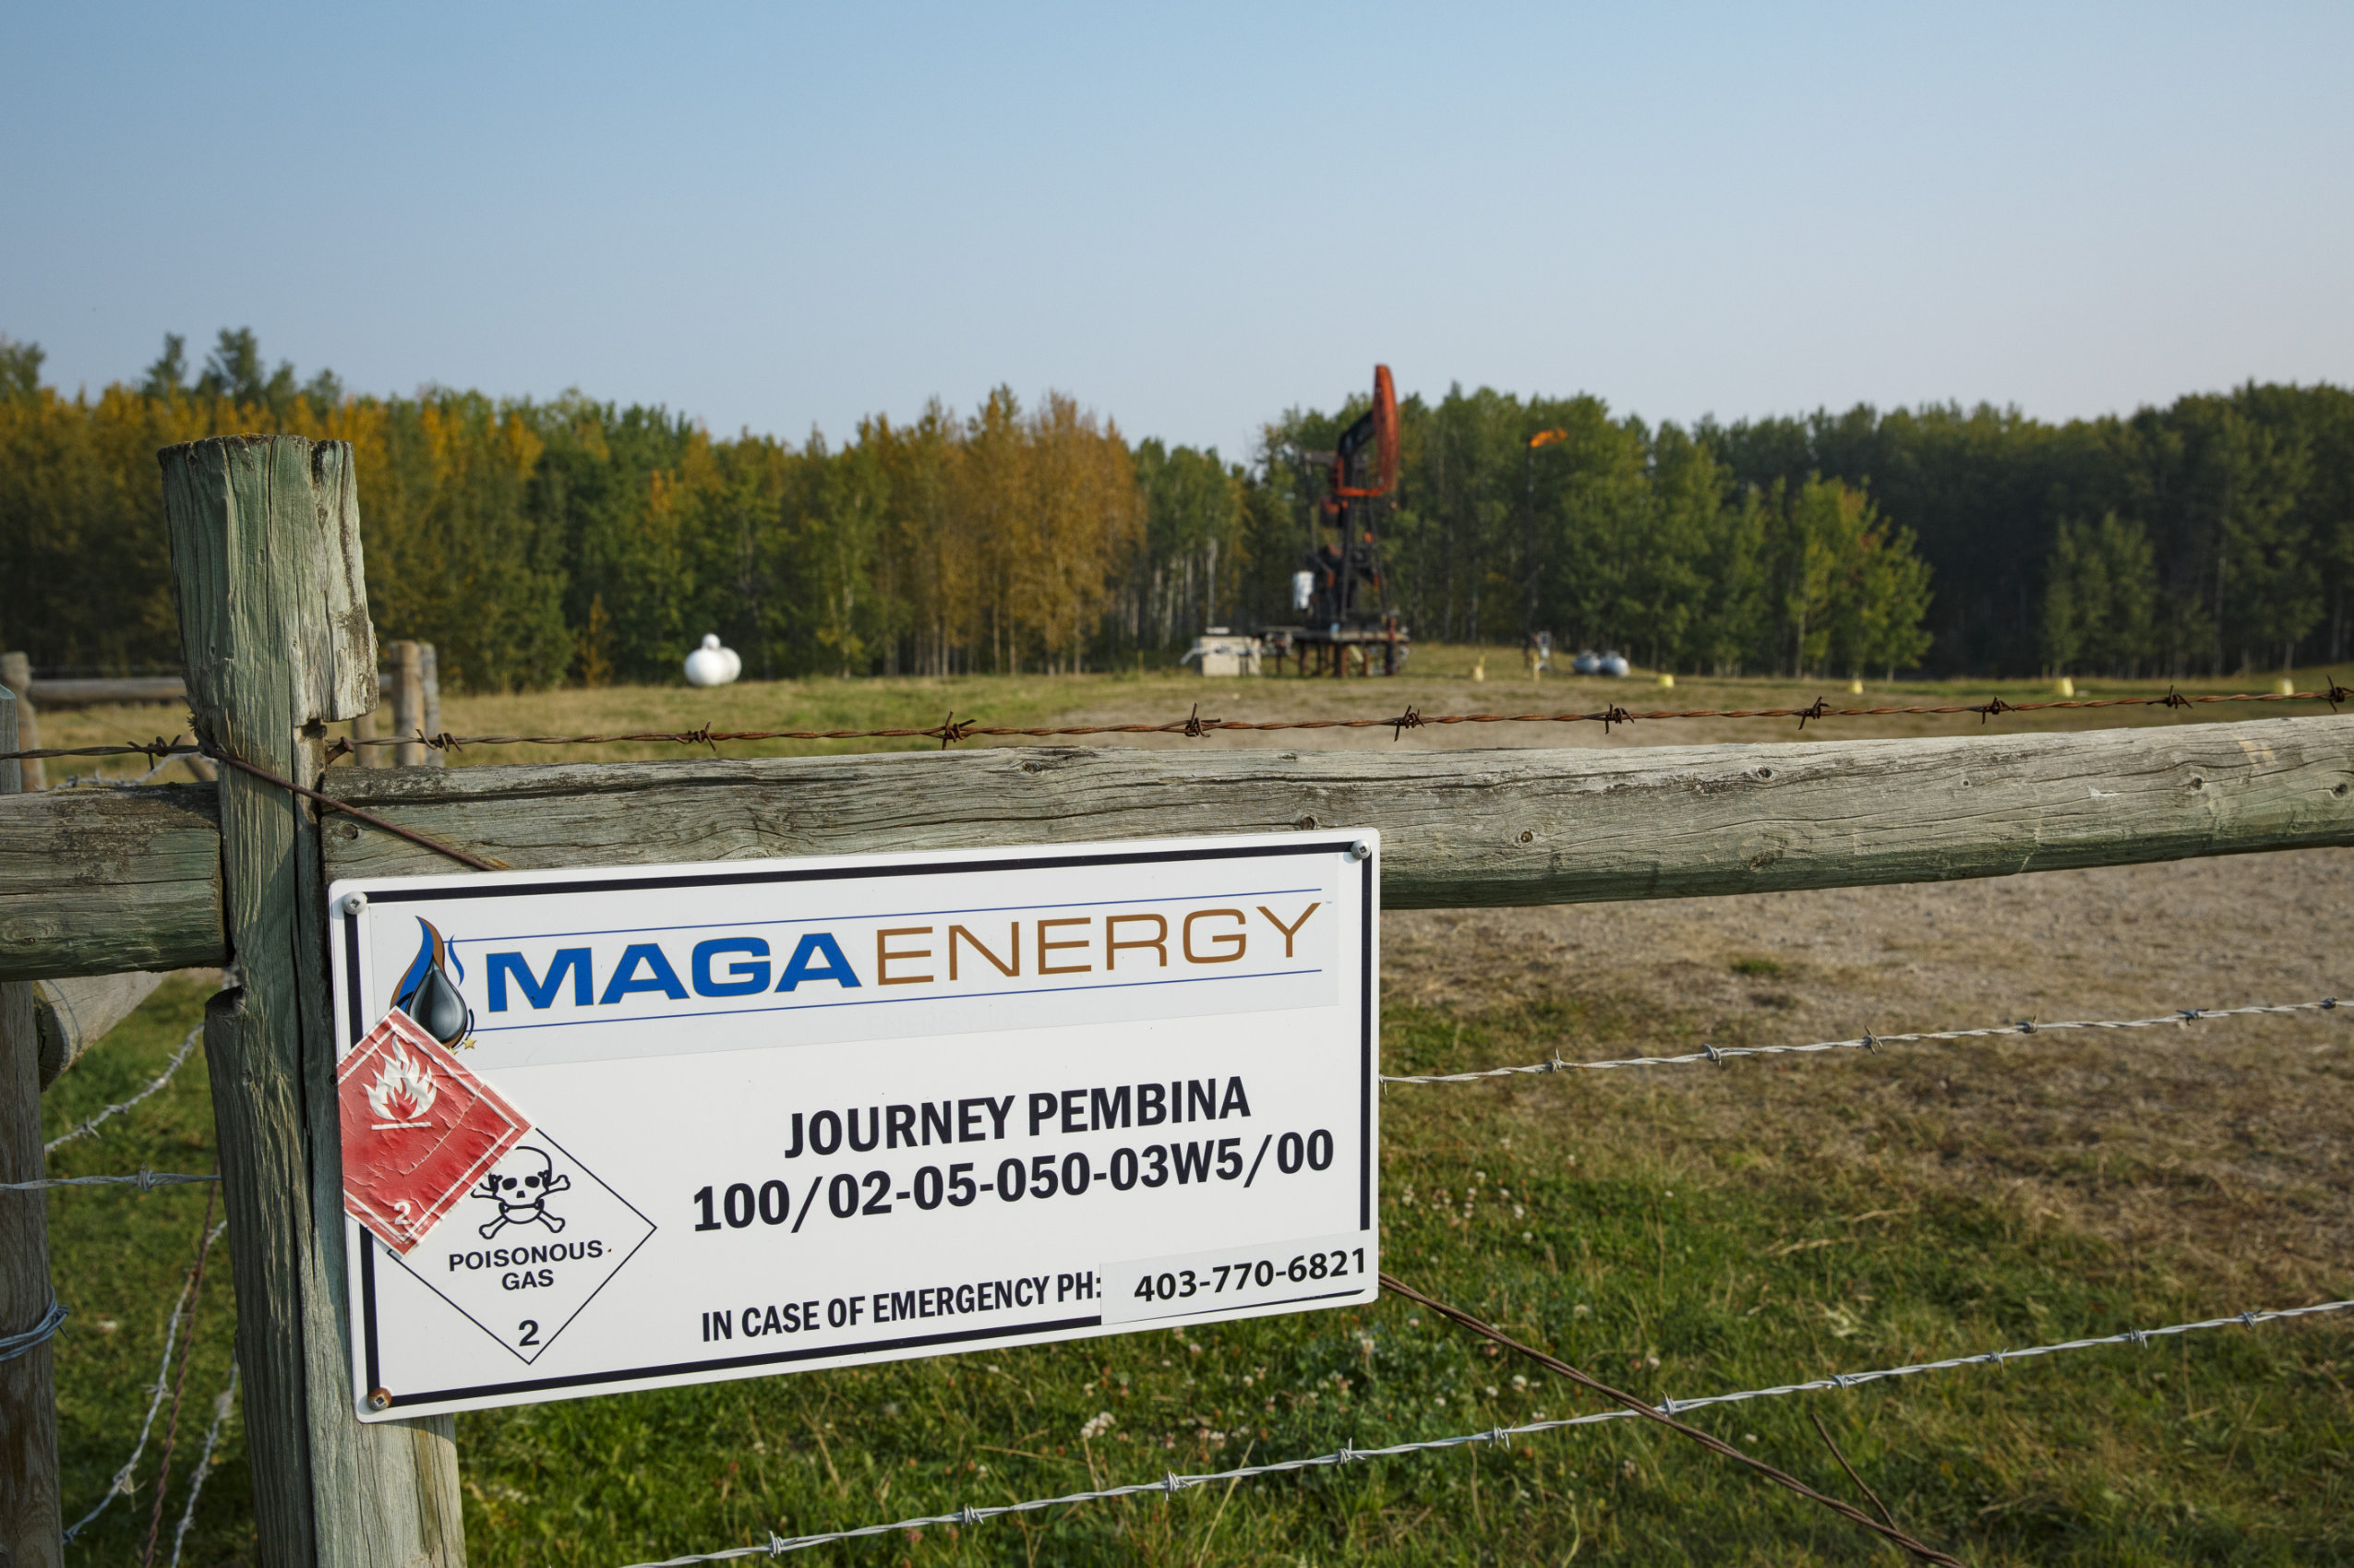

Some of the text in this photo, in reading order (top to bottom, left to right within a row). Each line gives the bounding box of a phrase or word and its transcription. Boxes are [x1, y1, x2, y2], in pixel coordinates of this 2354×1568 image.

[486, 902, 1322, 1012] MAGA ENERGY
[784, 1075, 1252, 1159] JOURNEY PEMBINA
[693, 1129, 1335, 1234] 100/02-05-050-03W5/00
[393, 1202, 412, 1226] 2
[449, 1239, 604, 1273] POISONOUS
[501, 1268, 555, 1291] GAS
[702, 1247, 1365, 1343] IN CASE OF EMERGENCY PH: 403-770-6821
[518, 1319, 540, 1347] 2
